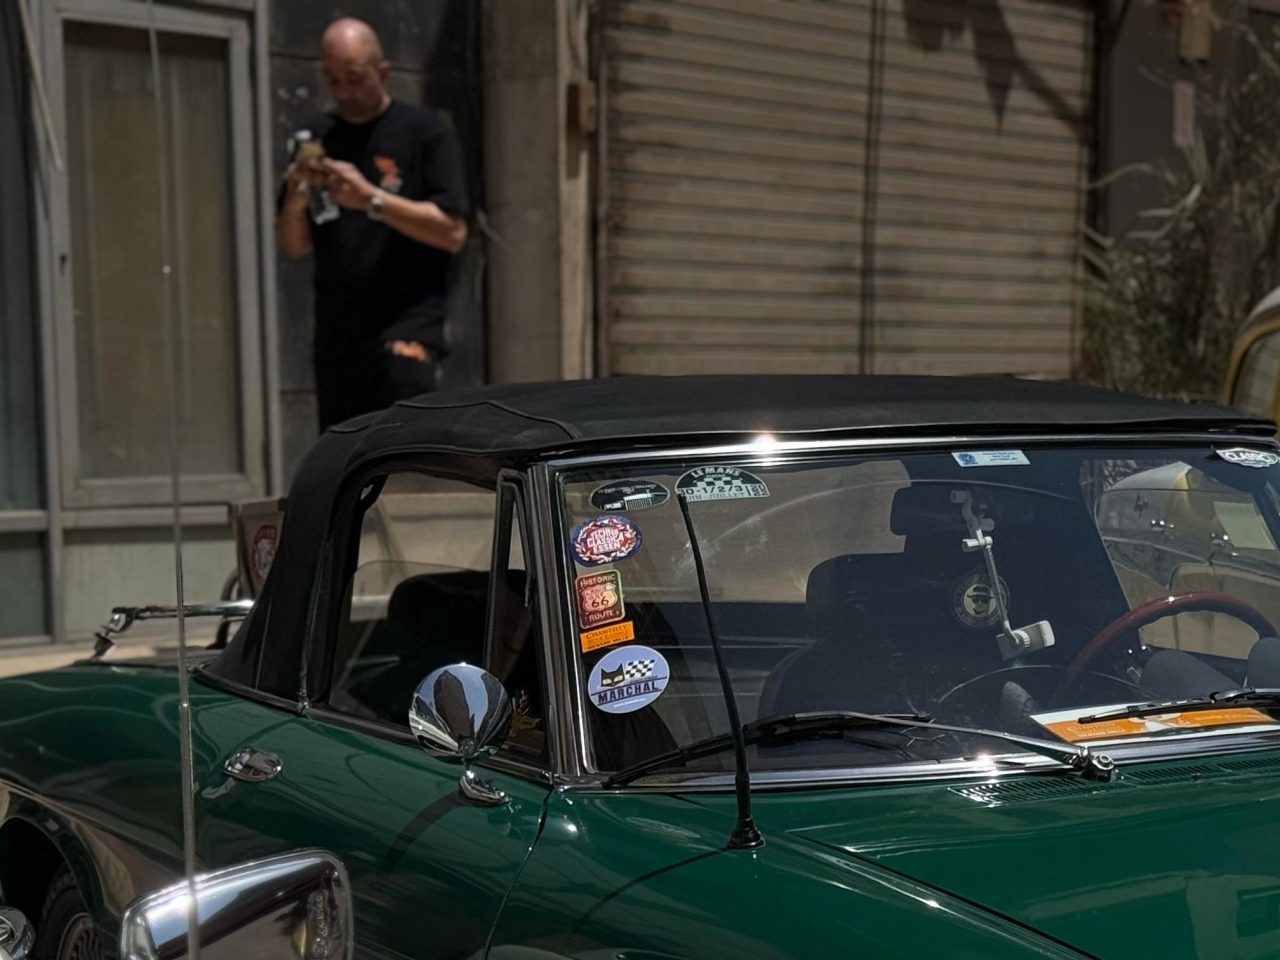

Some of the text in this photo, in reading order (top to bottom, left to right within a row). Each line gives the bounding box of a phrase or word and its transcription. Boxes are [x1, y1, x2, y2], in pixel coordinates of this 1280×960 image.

[705, 467, 741, 477] MANS
[579, 573, 616, 587] HISTORIC
[591, 595, 610, 609] 66
[588, 610, 615, 623] ROUTE
[597, 680, 660, 705] MARCHAL
